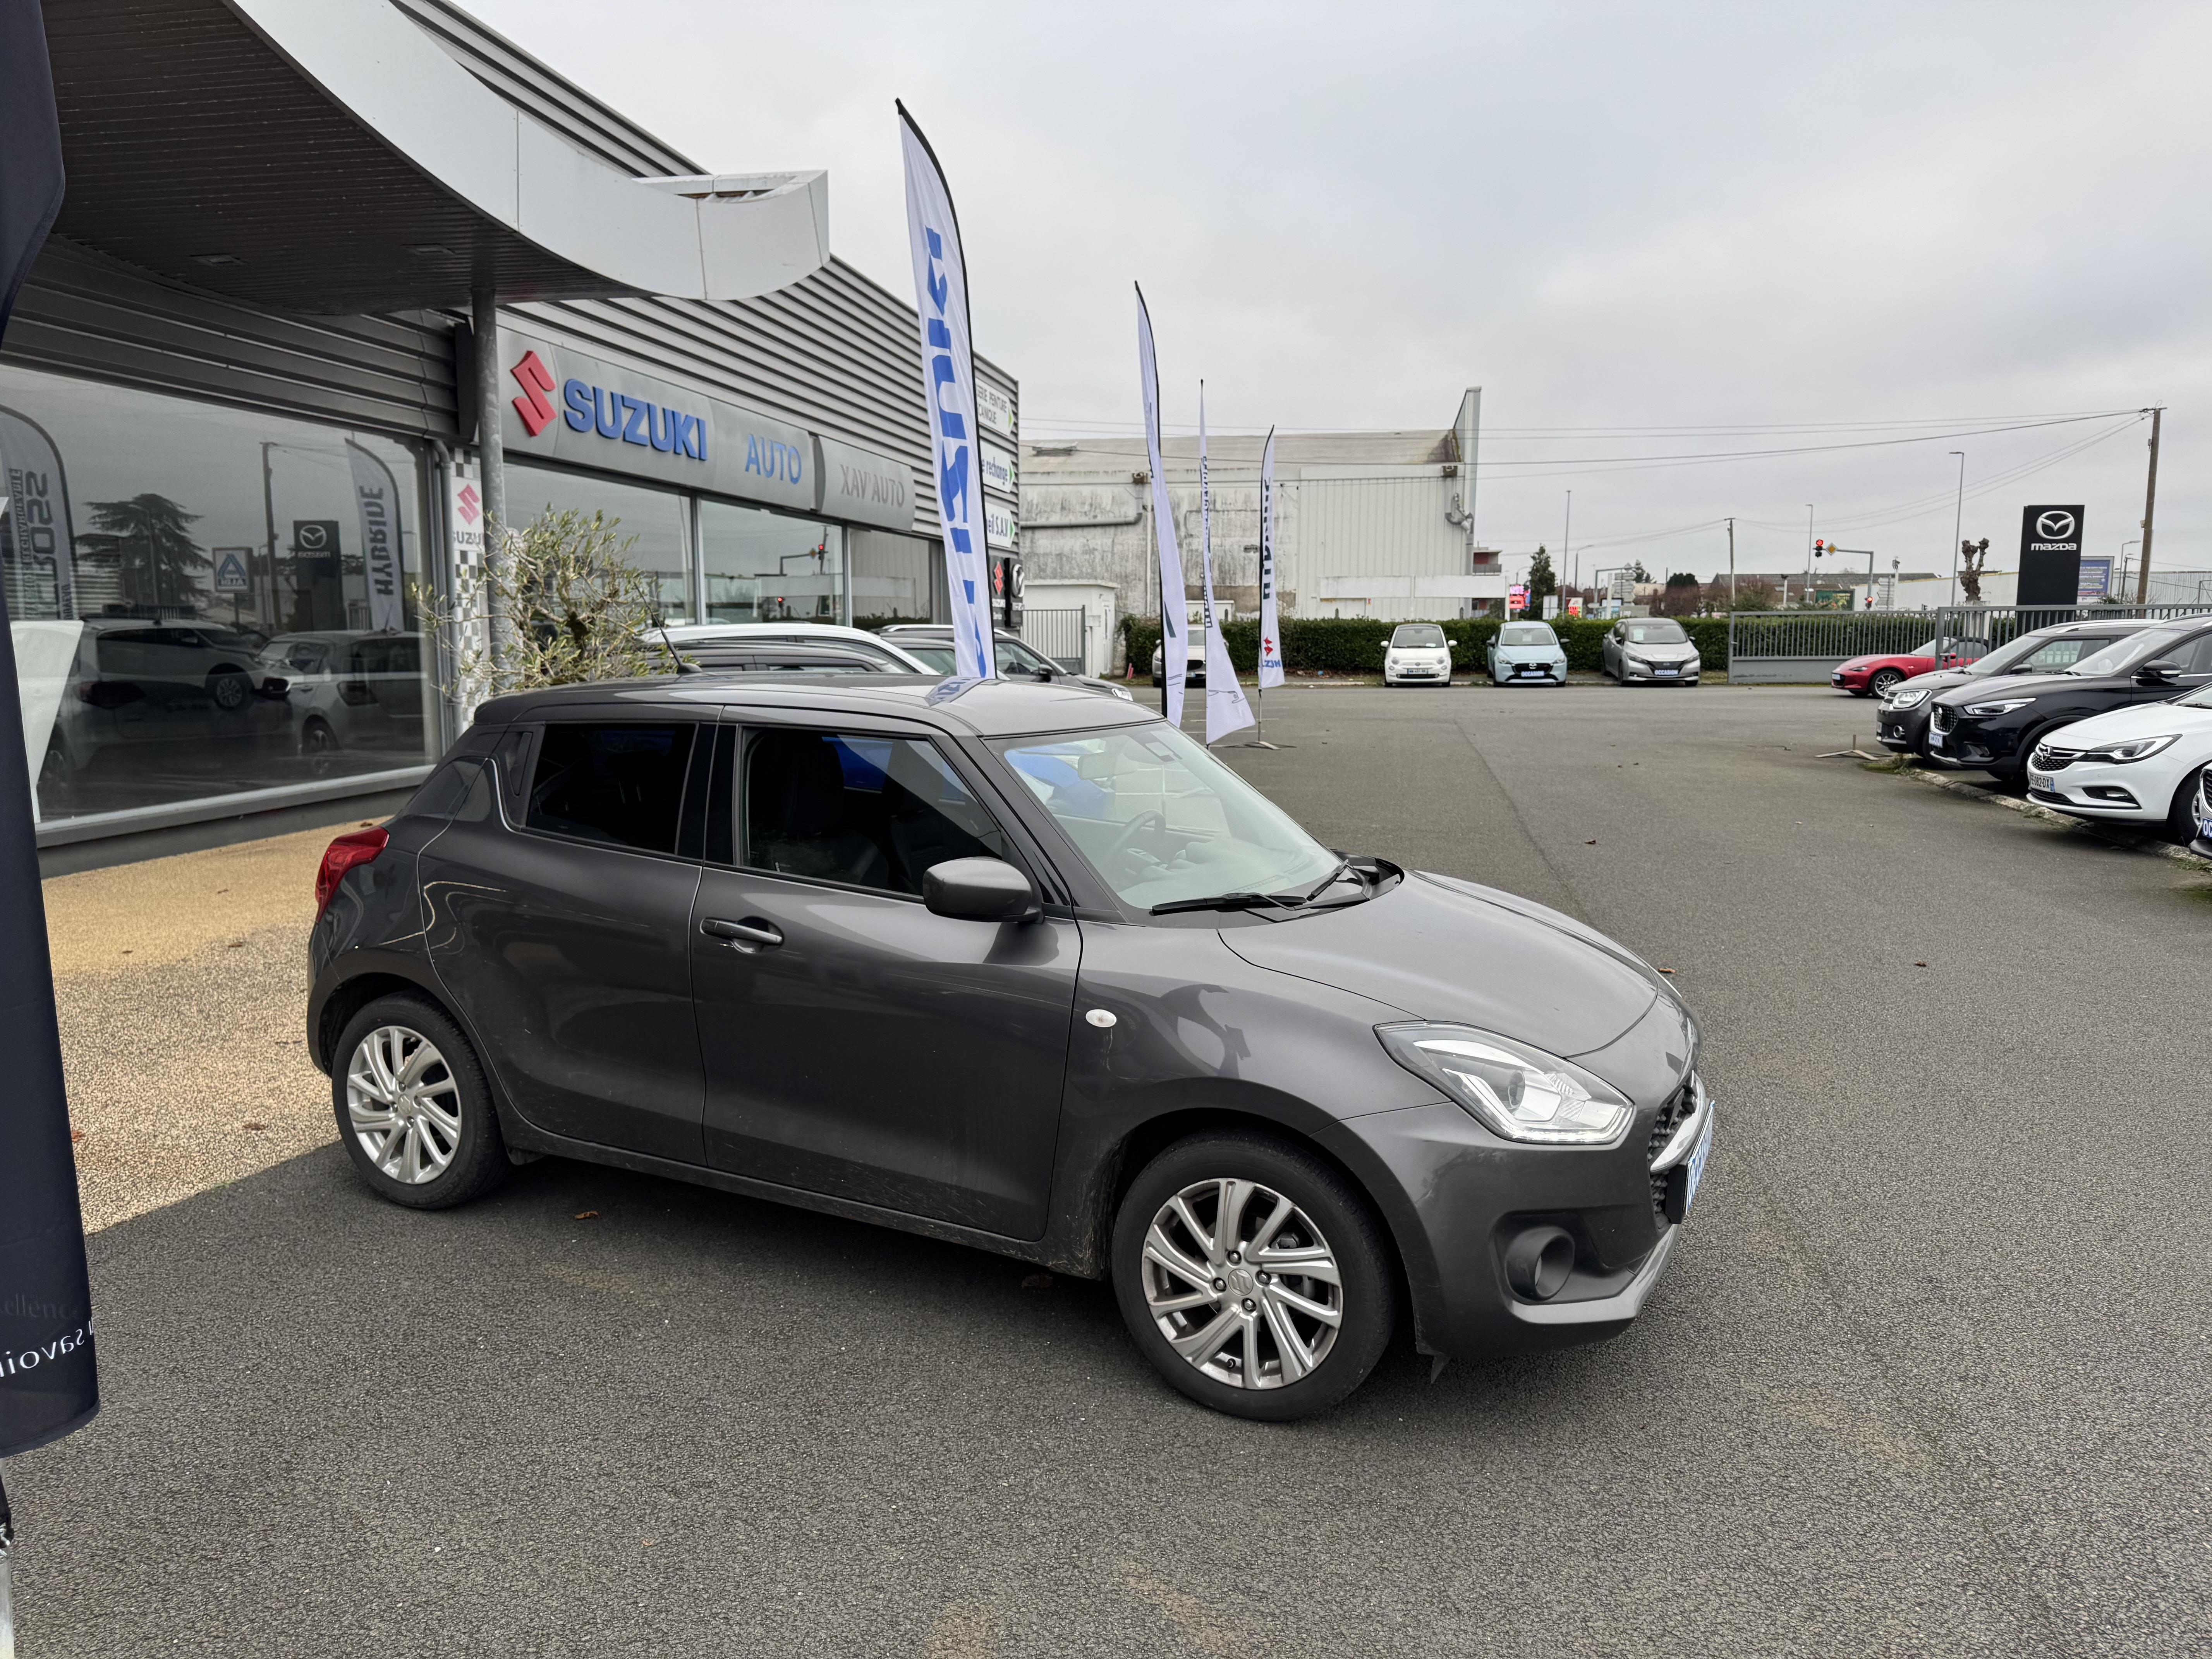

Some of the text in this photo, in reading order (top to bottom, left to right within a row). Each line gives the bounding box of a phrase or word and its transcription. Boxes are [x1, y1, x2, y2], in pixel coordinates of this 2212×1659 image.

[978, 404, 997, 424] CANIQUE
[564, 378, 802, 485] SUZUKI AUTO
[986, 457, 1008, 486] rechange
[840, 464, 905, 508] XAV'AUTO
[452, 531, 484, 545] SUZU
[2031, 543, 2076, 551] mazda
